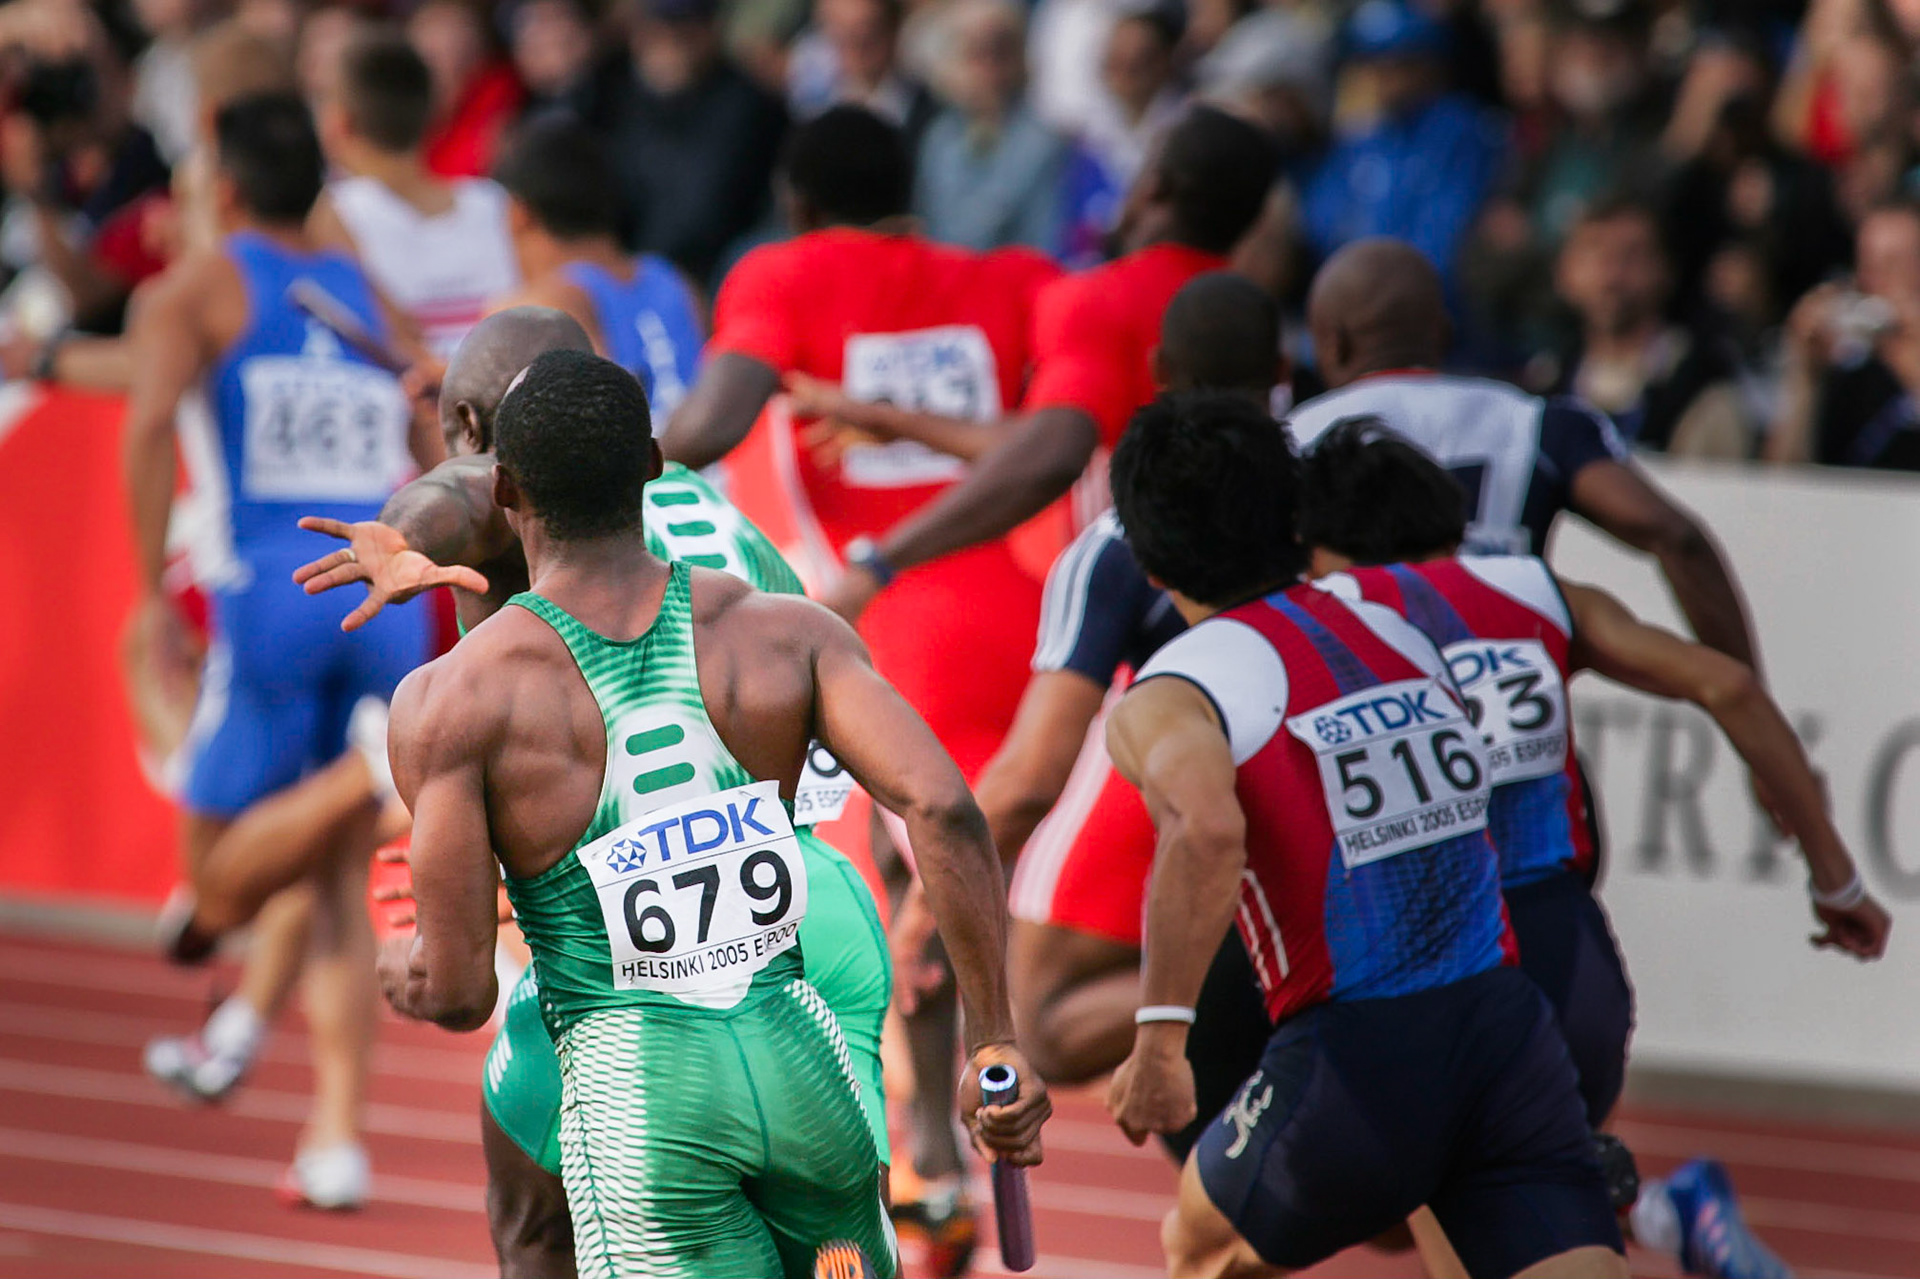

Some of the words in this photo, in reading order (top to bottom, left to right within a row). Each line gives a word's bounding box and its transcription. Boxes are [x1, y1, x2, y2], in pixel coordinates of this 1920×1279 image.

[1447, 646, 1532, 687] DK
[1336, 689, 1447, 735] TDK
[1335, 729, 1483, 821] 516
[638, 797, 776, 862] TDK
[1343, 817, 1418, 857] HELSINKI
[1420, 803, 1456, 833] 2005
[623, 849, 793, 954] 679
[621, 952, 705, 980] HELSINKI
[707, 942, 749, 971] 2005
